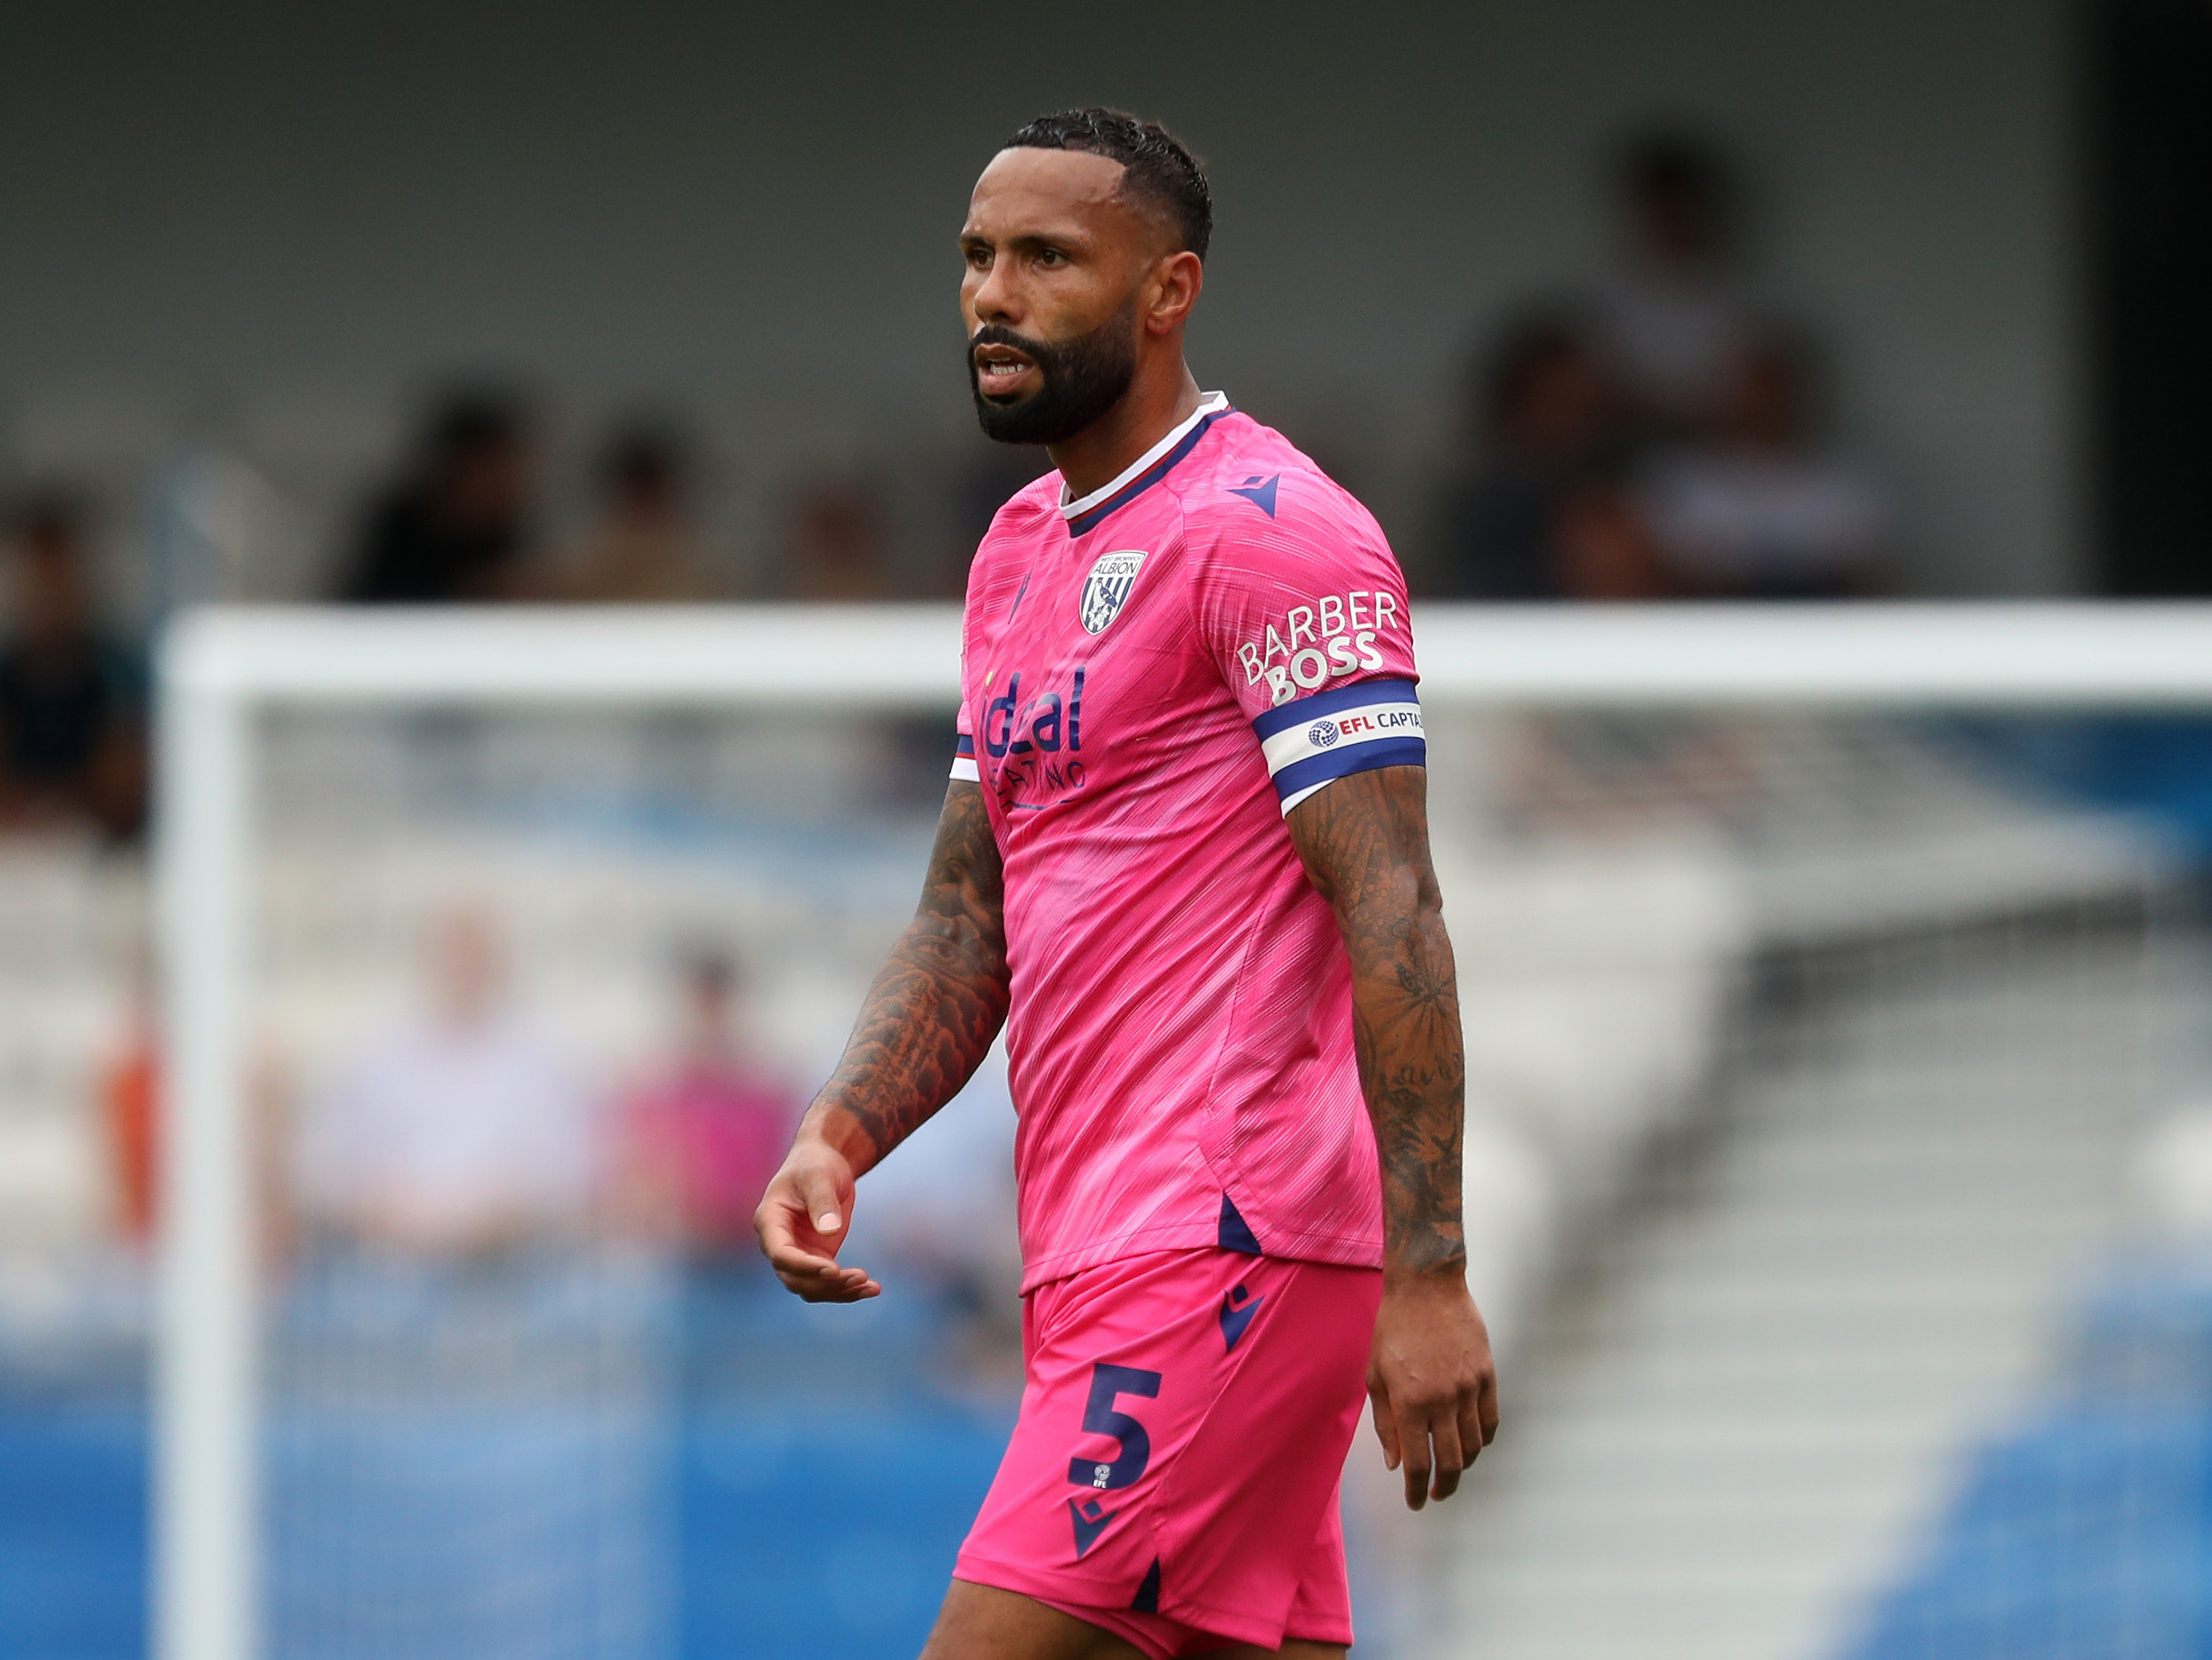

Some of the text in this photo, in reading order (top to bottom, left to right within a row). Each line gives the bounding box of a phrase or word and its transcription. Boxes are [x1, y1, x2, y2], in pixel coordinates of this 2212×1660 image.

[1092, 562, 1138, 575] ALBION
[1237, 591, 1398, 686] BARBER
[1264, 631, 1383, 707] BOSS
[1339, 712, 1423, 736] EFL CAPTA
[1068, 1363, 1162, 1490] 5
[1092, 1479, 1107, 1490] EFL
